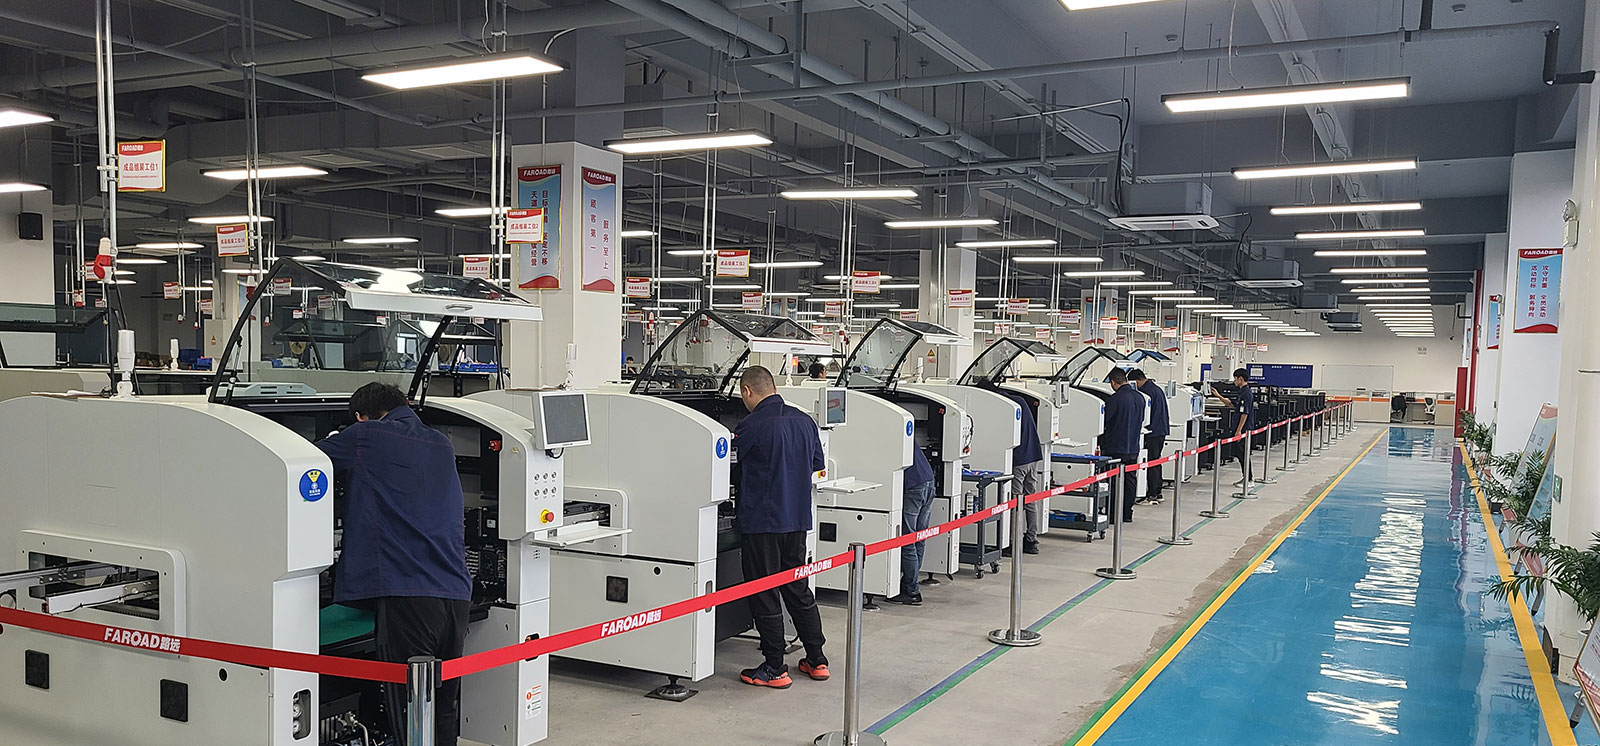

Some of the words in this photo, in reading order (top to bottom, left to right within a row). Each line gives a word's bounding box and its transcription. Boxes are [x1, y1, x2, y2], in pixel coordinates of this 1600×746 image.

[590, 199, 598, 249] 顾客第一
[104, 627, 181, 652] FAROAD路远
